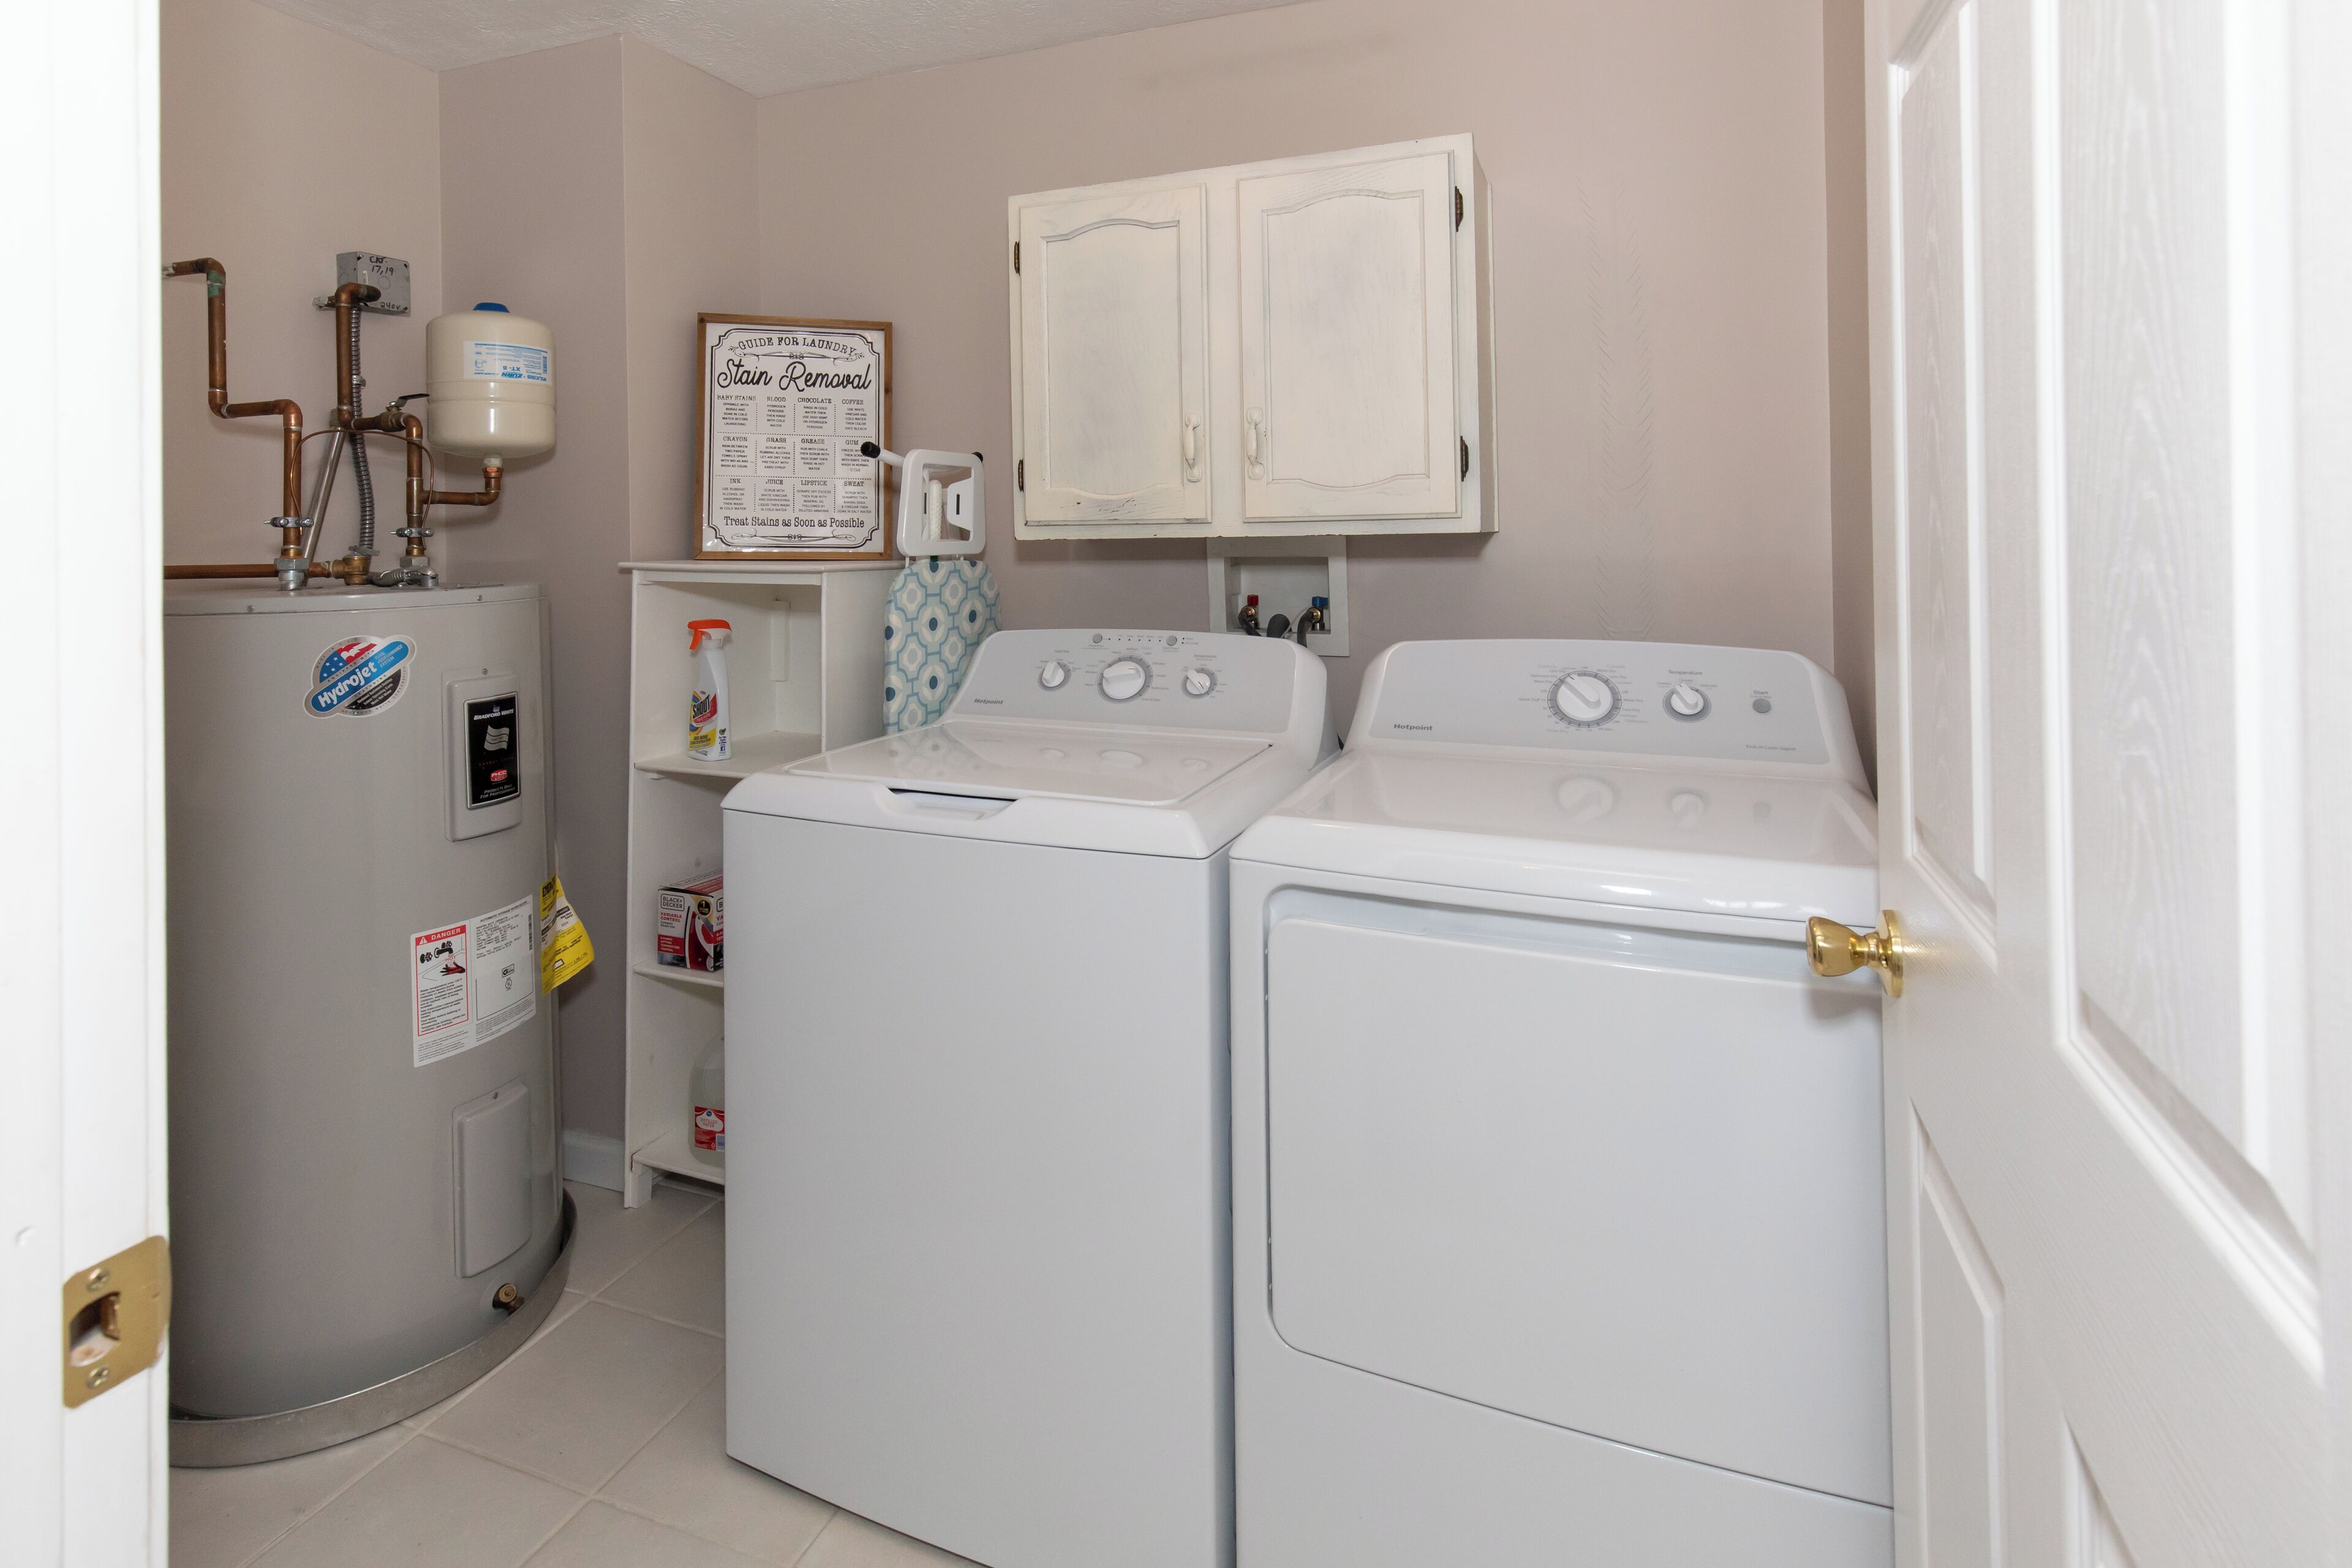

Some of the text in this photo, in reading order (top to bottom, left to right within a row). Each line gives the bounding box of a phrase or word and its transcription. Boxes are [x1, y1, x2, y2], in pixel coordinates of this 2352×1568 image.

[739, 337, 856, 356] GUIDE FOR LAUNDRY
[718, 358, 871, 392] Stain Removal
[724, 516, 749, 526] Treat
[752, 517, 779, 526] Stains
[794, 517, 815, 527] Soon
[830, 518, 864, 527] Possible
[377, 644, 403, 664] PERFORMANCE
[380, 656, 394, 668] SYSTEM
[328, 662, 356, 682] EQUIPPED
[318, 662, 377, 707] Hydrojet
[354, 675, 386, 698] FEATURING
[474, 712, 500, 720] BRADFORD
[693, 694, 710, 719] SHOUT
[432, 928, 460, 940] DANGER
